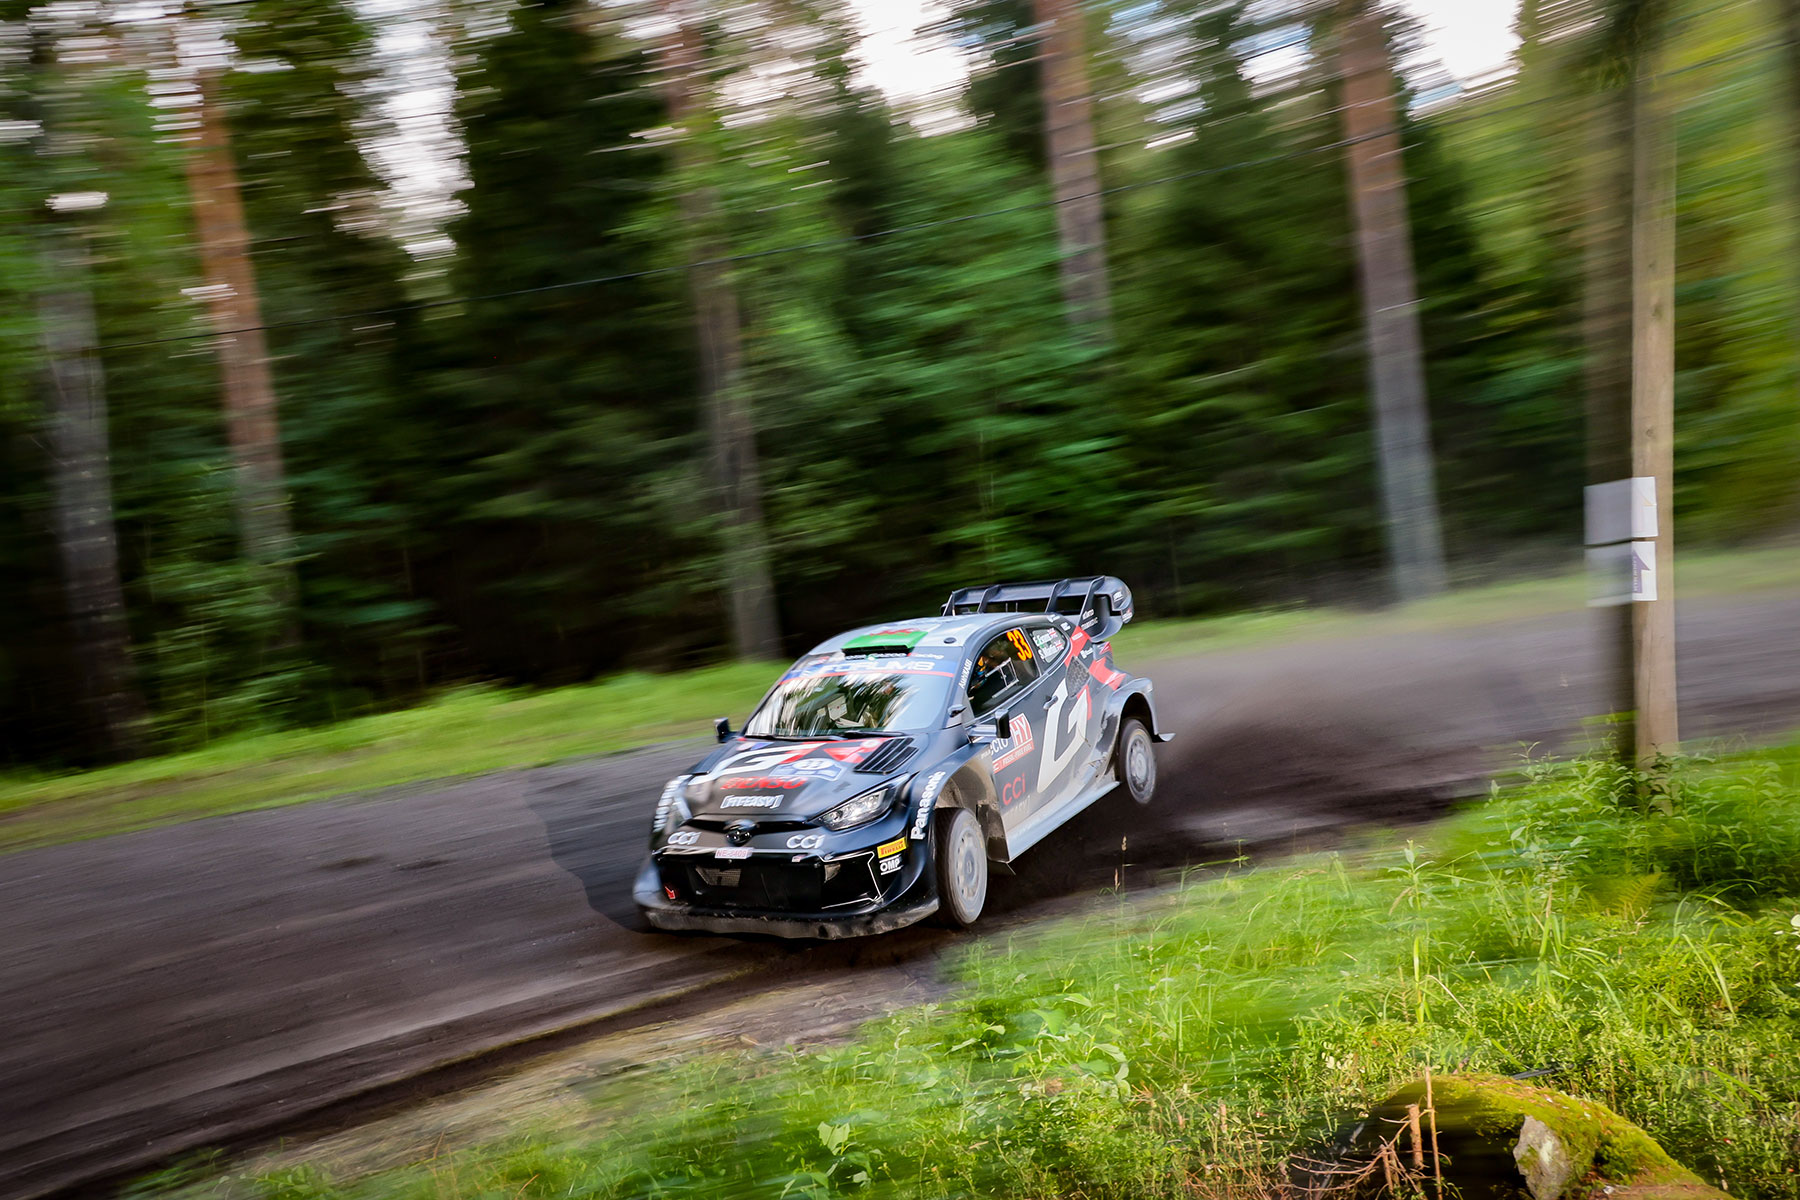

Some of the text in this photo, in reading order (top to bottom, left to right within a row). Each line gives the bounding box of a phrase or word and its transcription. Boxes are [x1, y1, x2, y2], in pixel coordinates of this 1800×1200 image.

[1007, 629, 1033, 661] 33
[1012, 716, 1030, 747] HY
[721, 776, 807, 789] DENSO
[911, 771, 946, 840] Panasonic
[879, 857, 901, 872] OMP
